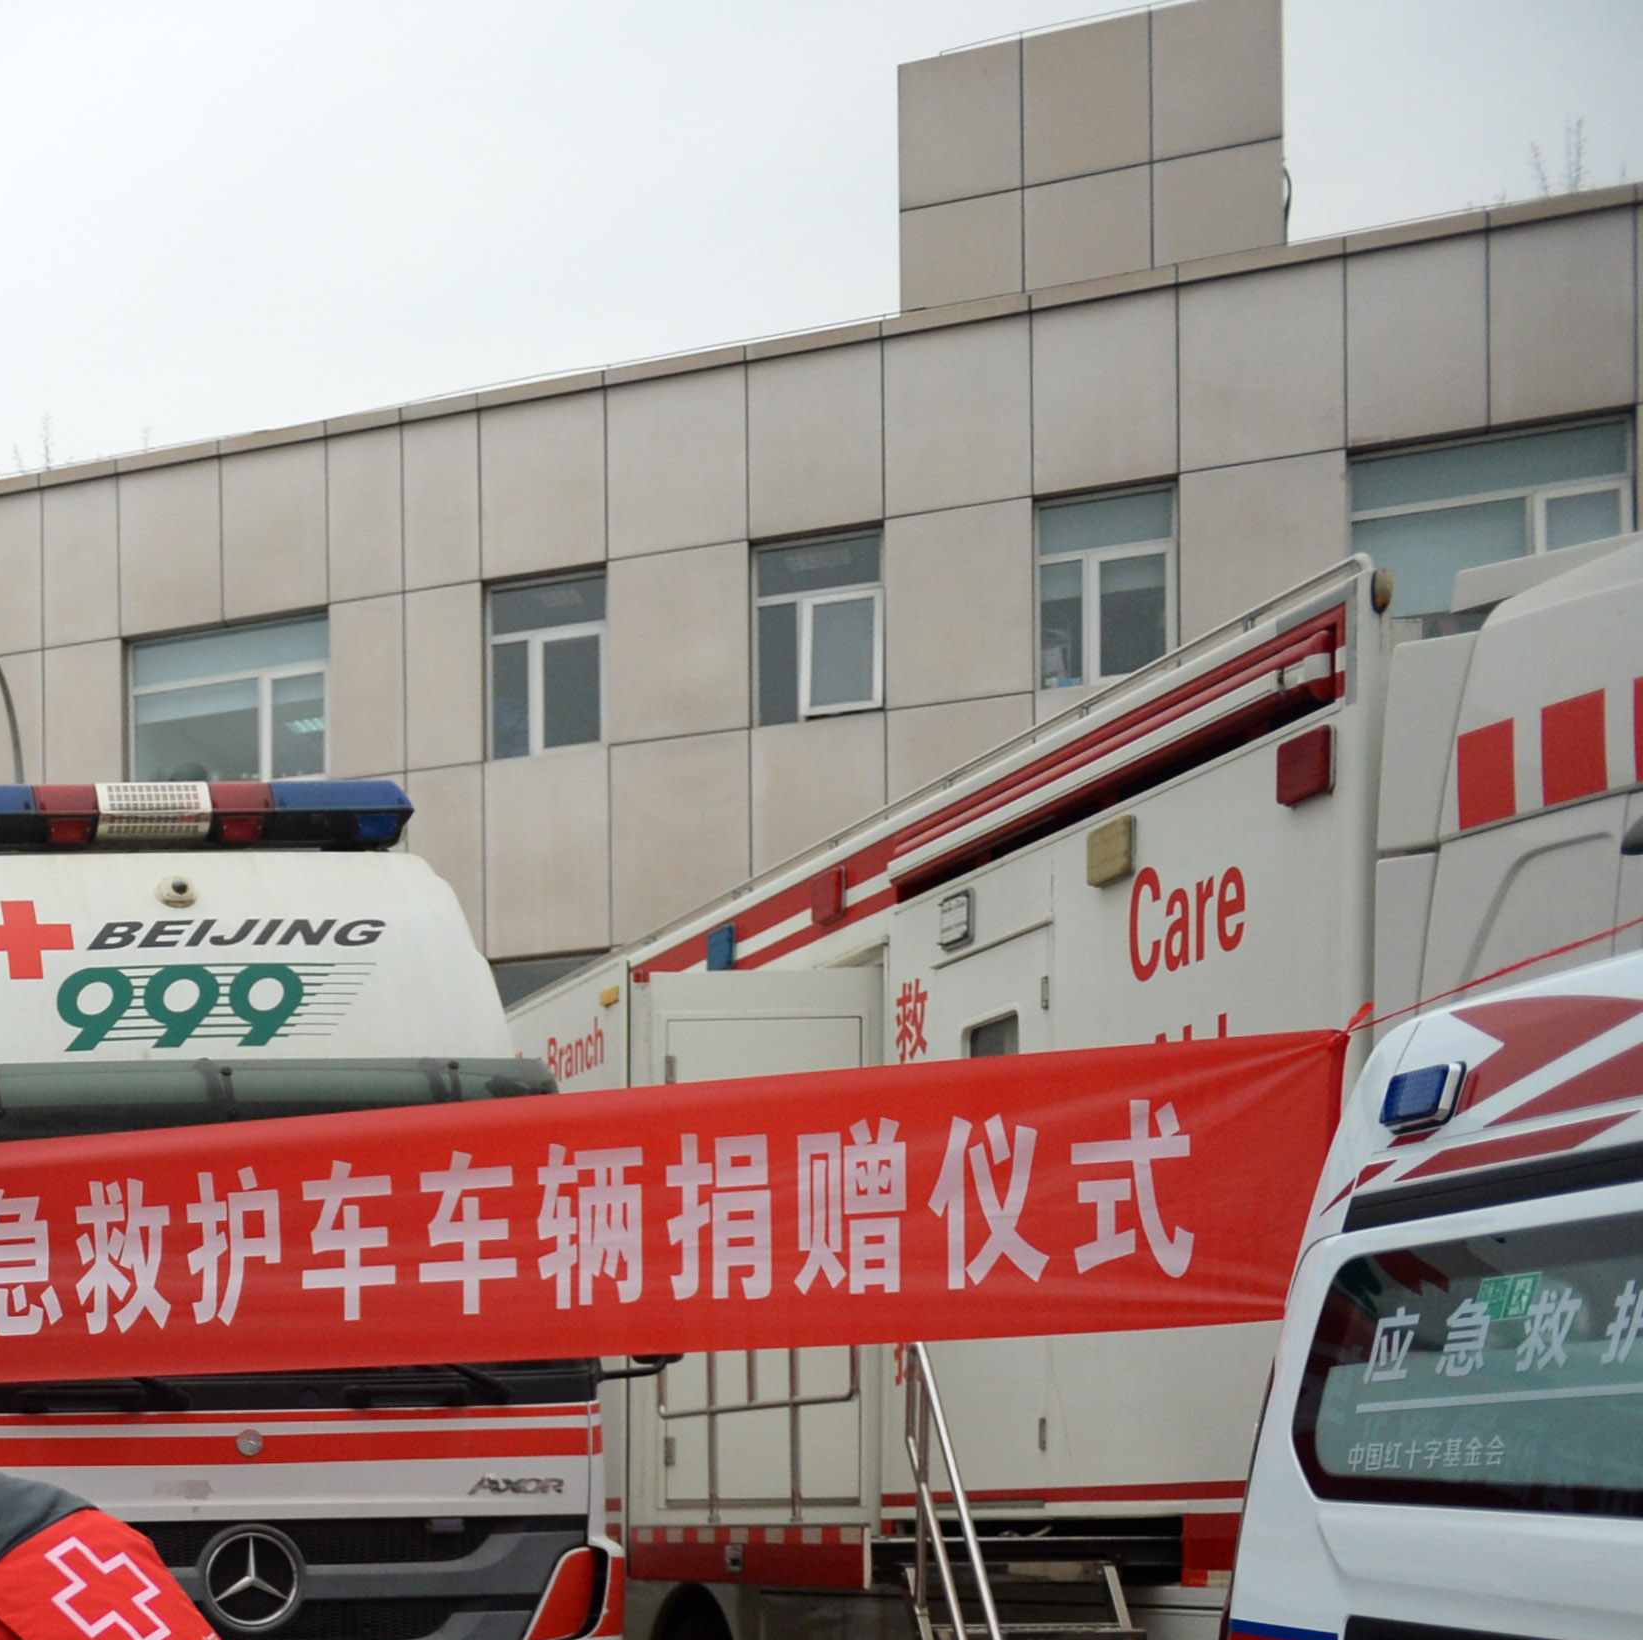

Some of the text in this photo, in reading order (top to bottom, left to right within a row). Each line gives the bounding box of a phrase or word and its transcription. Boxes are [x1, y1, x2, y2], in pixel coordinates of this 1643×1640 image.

[87, 918, 385, 951] BEIJING
[1129, 864, 1246, 983] Care
[56, 963, 307, 1053] 999
[1347, 1435, 1506, 1473] 中国红十字基金会
